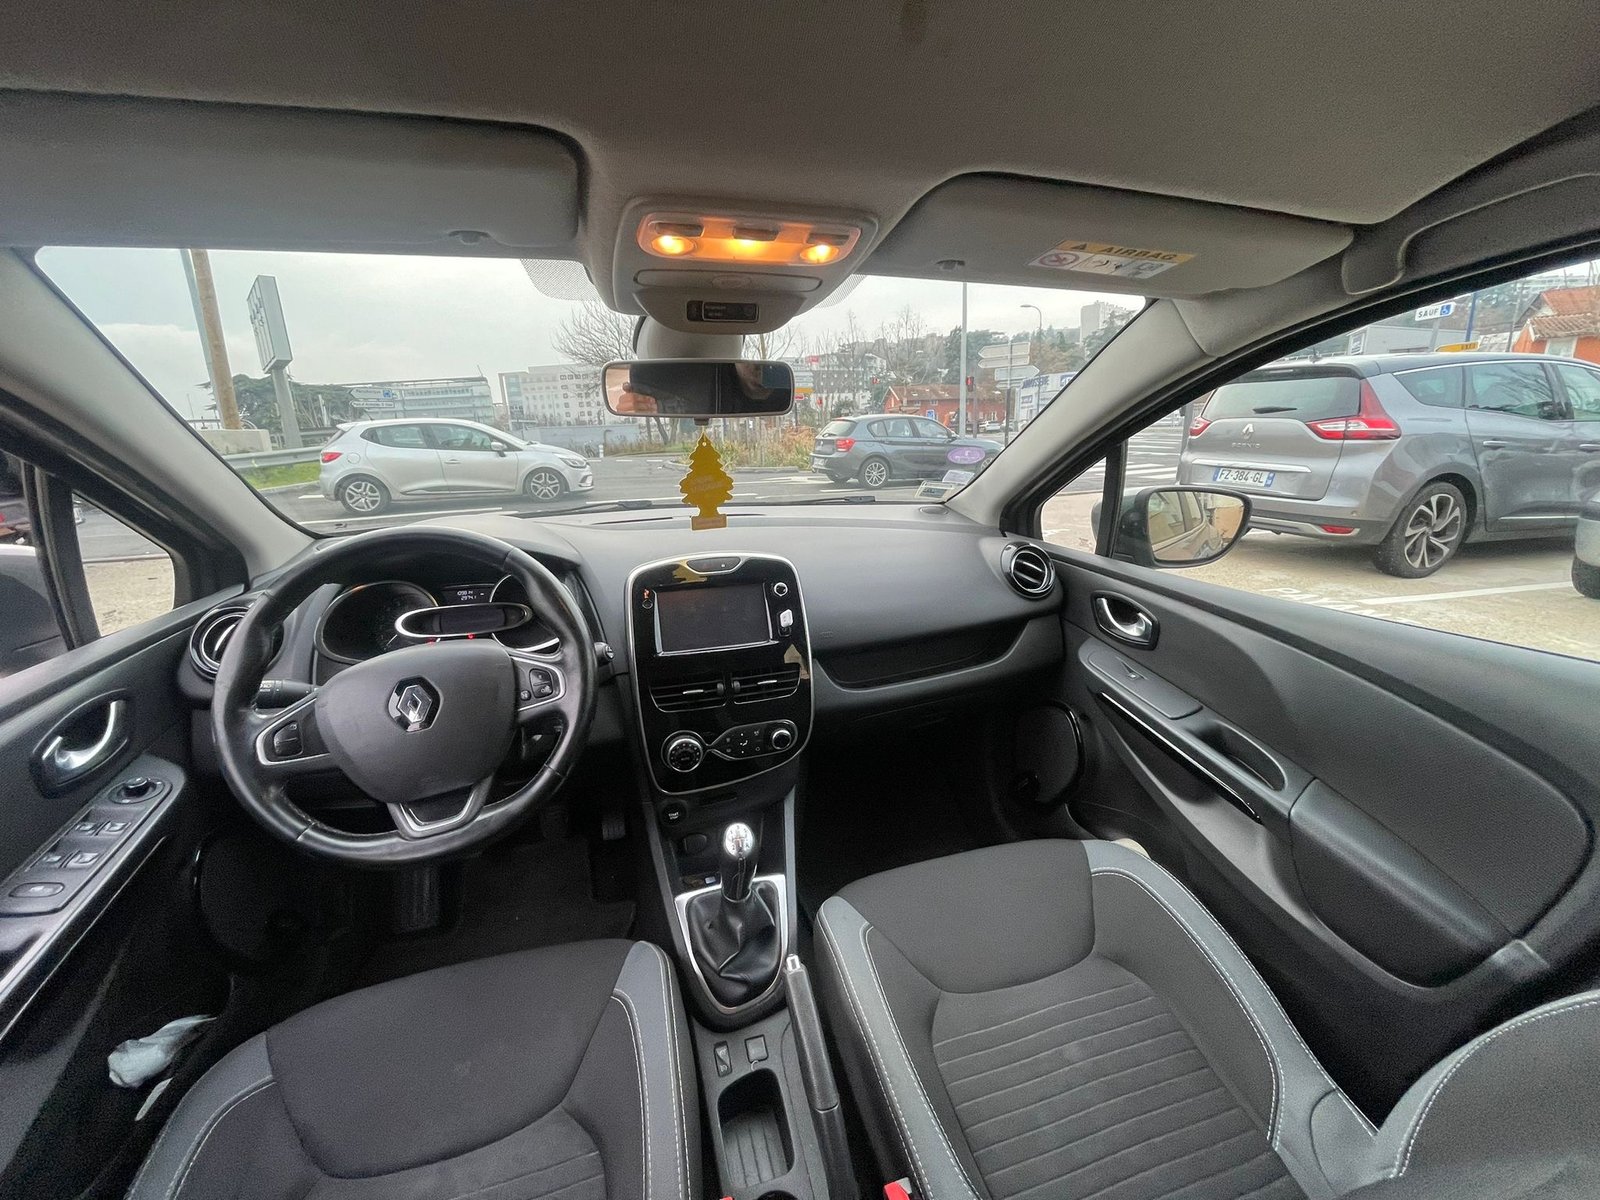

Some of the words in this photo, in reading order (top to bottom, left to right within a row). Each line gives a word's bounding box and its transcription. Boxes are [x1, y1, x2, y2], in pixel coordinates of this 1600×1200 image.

[1099, 246, 1177, 260] AIRBAG
[1418, 308, 1439, 318] SAUF
[1218, 469, 1264, 484] FZ-384-GL
